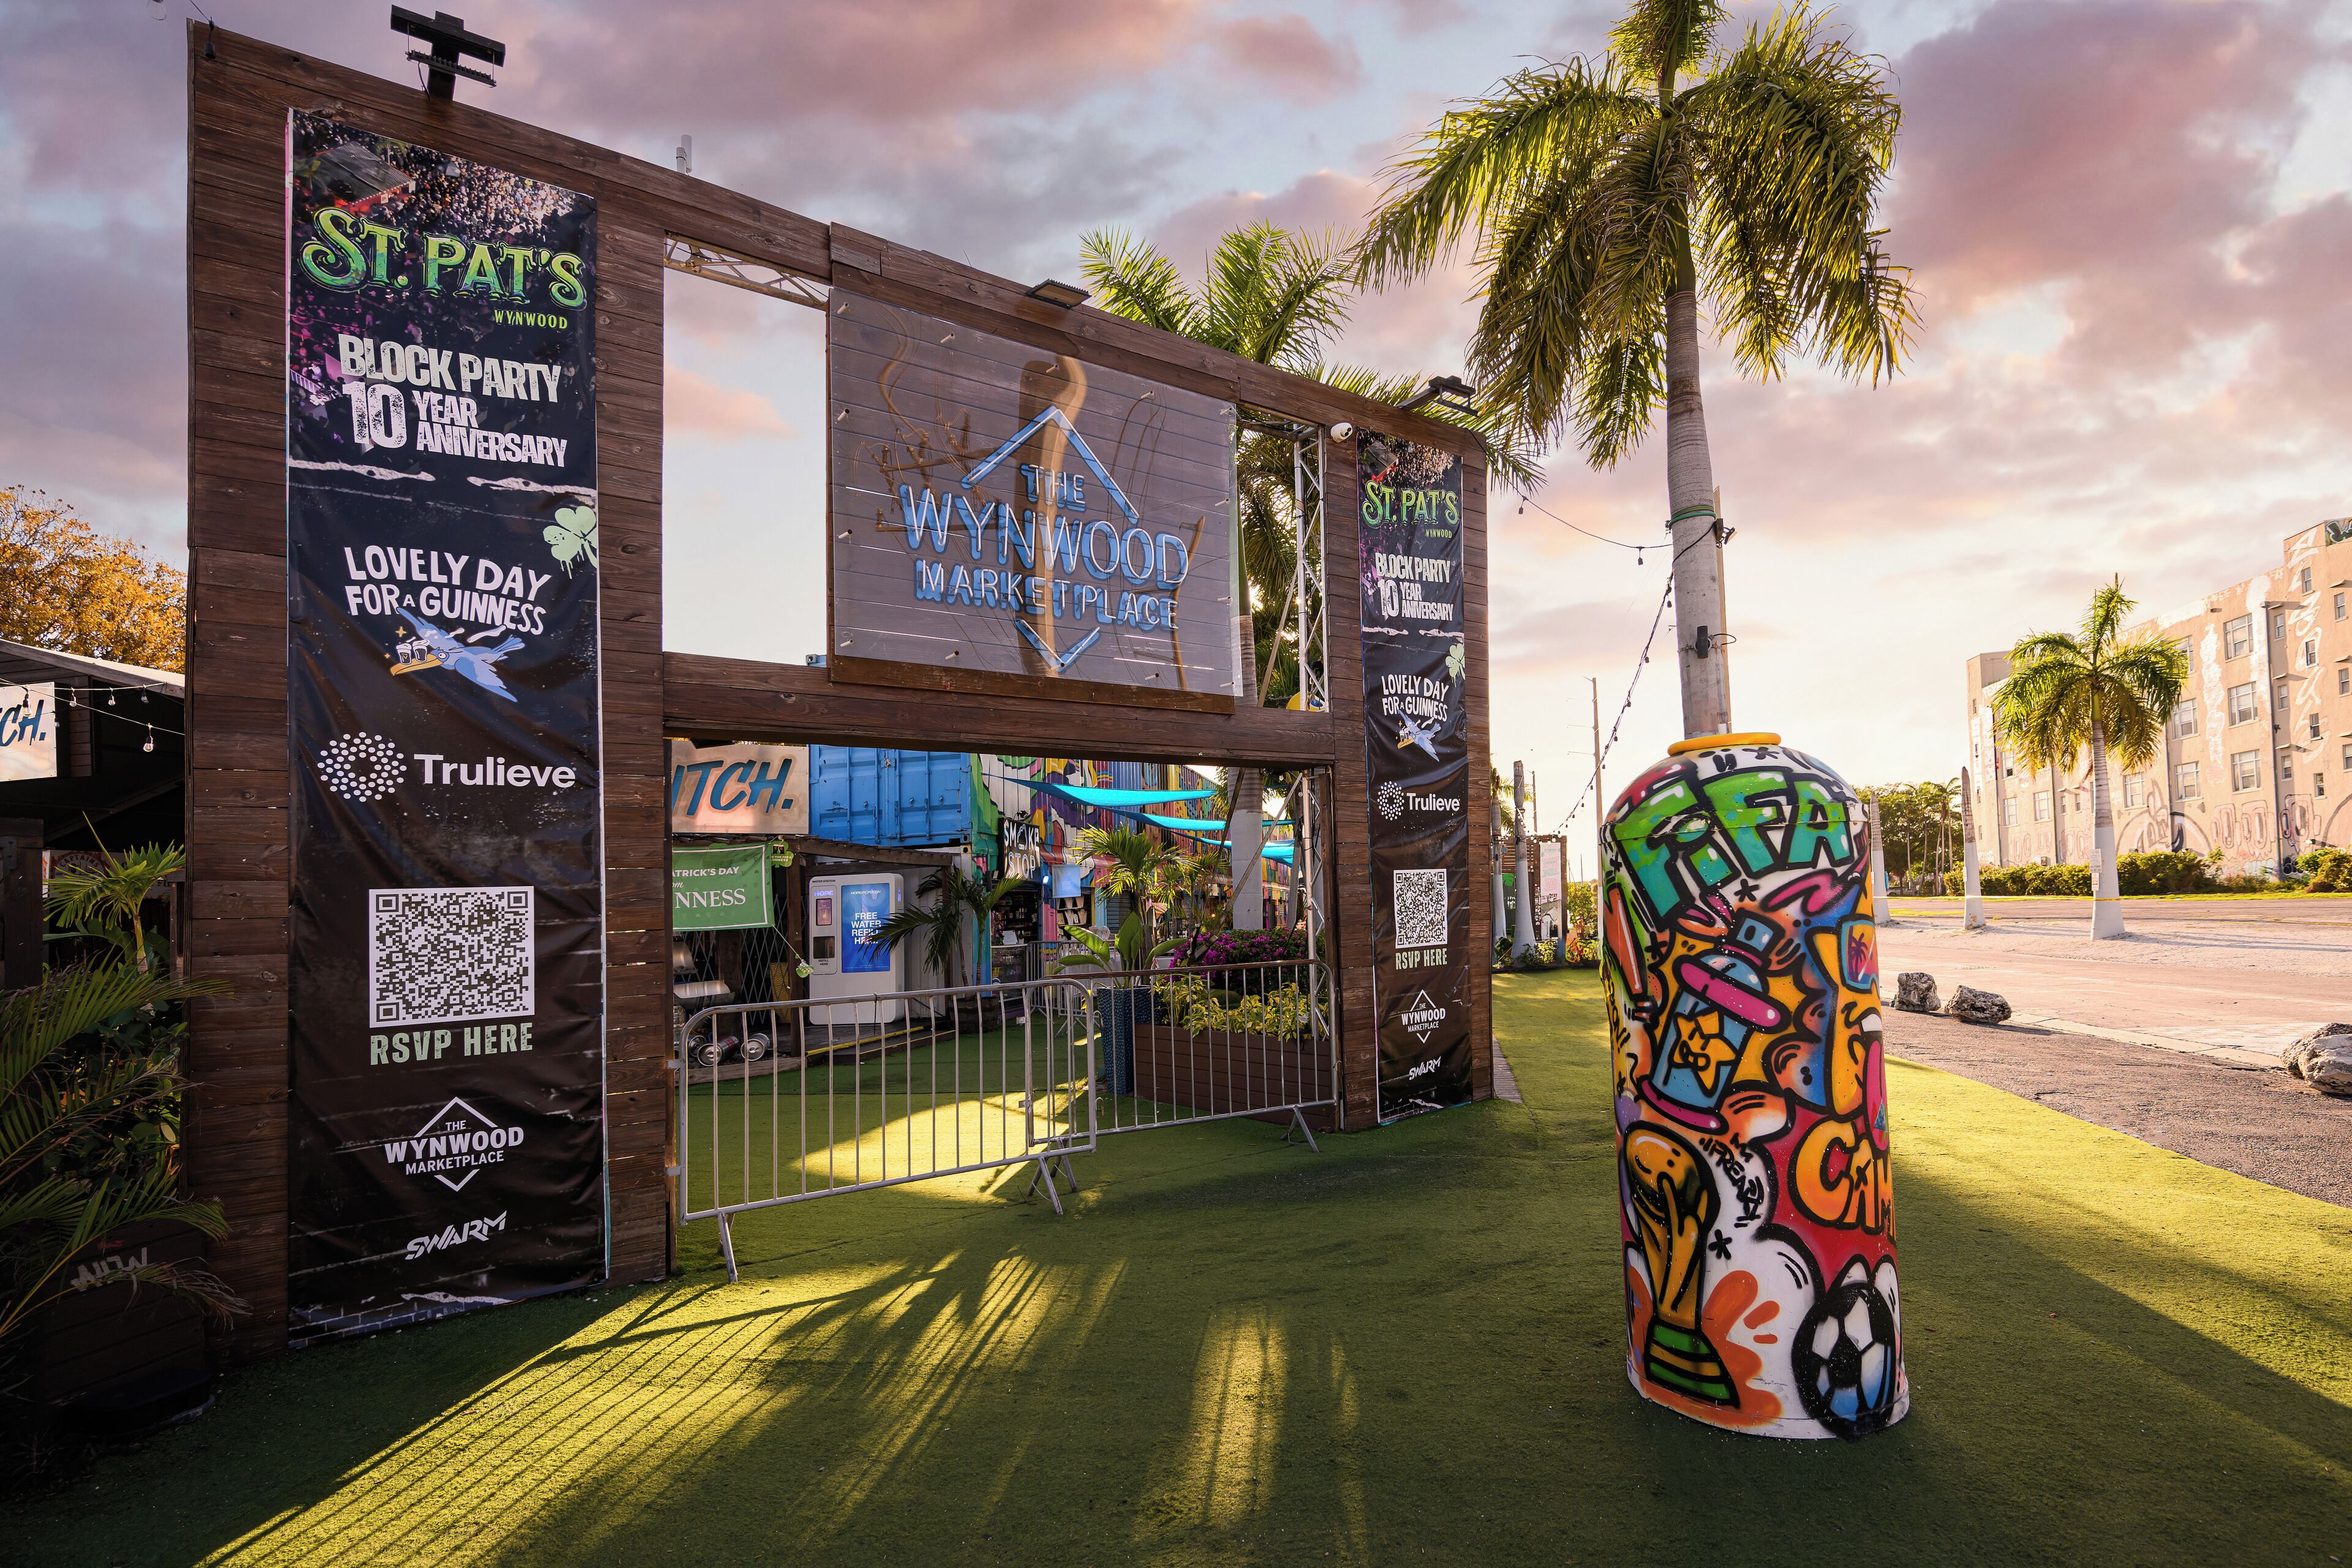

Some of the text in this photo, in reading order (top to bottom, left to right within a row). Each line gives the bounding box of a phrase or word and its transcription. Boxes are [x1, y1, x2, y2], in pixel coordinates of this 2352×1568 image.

[299, 206, 587, 311] ST. PAT'S
[494, 309, 568, 330] WYNWOOD
[338, 333, 562, 403] BLOCK PARTY
[342, 380, 478, 448] 10 YEAR
[1020, 463, 1087, 511] THE
[1362, 480, 1459, 529] ST. PAT'S
[899, 484, 1189, 590] WYNWOOD
[1425, 529, 1452, 538] WYNWOOD
[344, 545, 552, 601] LOVELY DAY
[1375, 552, 1450, 583] BLOCK PARTY
[345, 584, 546, 635] FOR A GUINNESS
[1378, 579, 1422, 617] 10 YEAR
[1381, 674, 1449, 702] LOVELY DAY
[0, 699, 46, 747] CH.
[1382, 696, 1400, 716] FOR
[1405, 697, 1448, 722] GUINNESS
[414, 753, 576, 788] Trulieve
[1406, 793, 1460, 812] Trulieve
[718, 867, 739, 875] DAY
[1008, 851, 1036, 879] STOP
[674, 888, 746, 909] NNESS
[1395, 948, 1447, 970] RSVP HERE
[1401, 1008, 1446, 1025] WYNWOOD
[1408, 1021, 1439, 1032] MARKETPLACE
[370, 1022, 533, 1066] RSVP HERE
[1409, 1056, 1441, 1080] SWARM
[445, 1120, 467, 1131] THE
[385, 1127, 524, 1163] WYNWOOD
[405, 1150, 504, 1175] MARKETPLACE
[405, 1210, 507, 1260] SWARM
